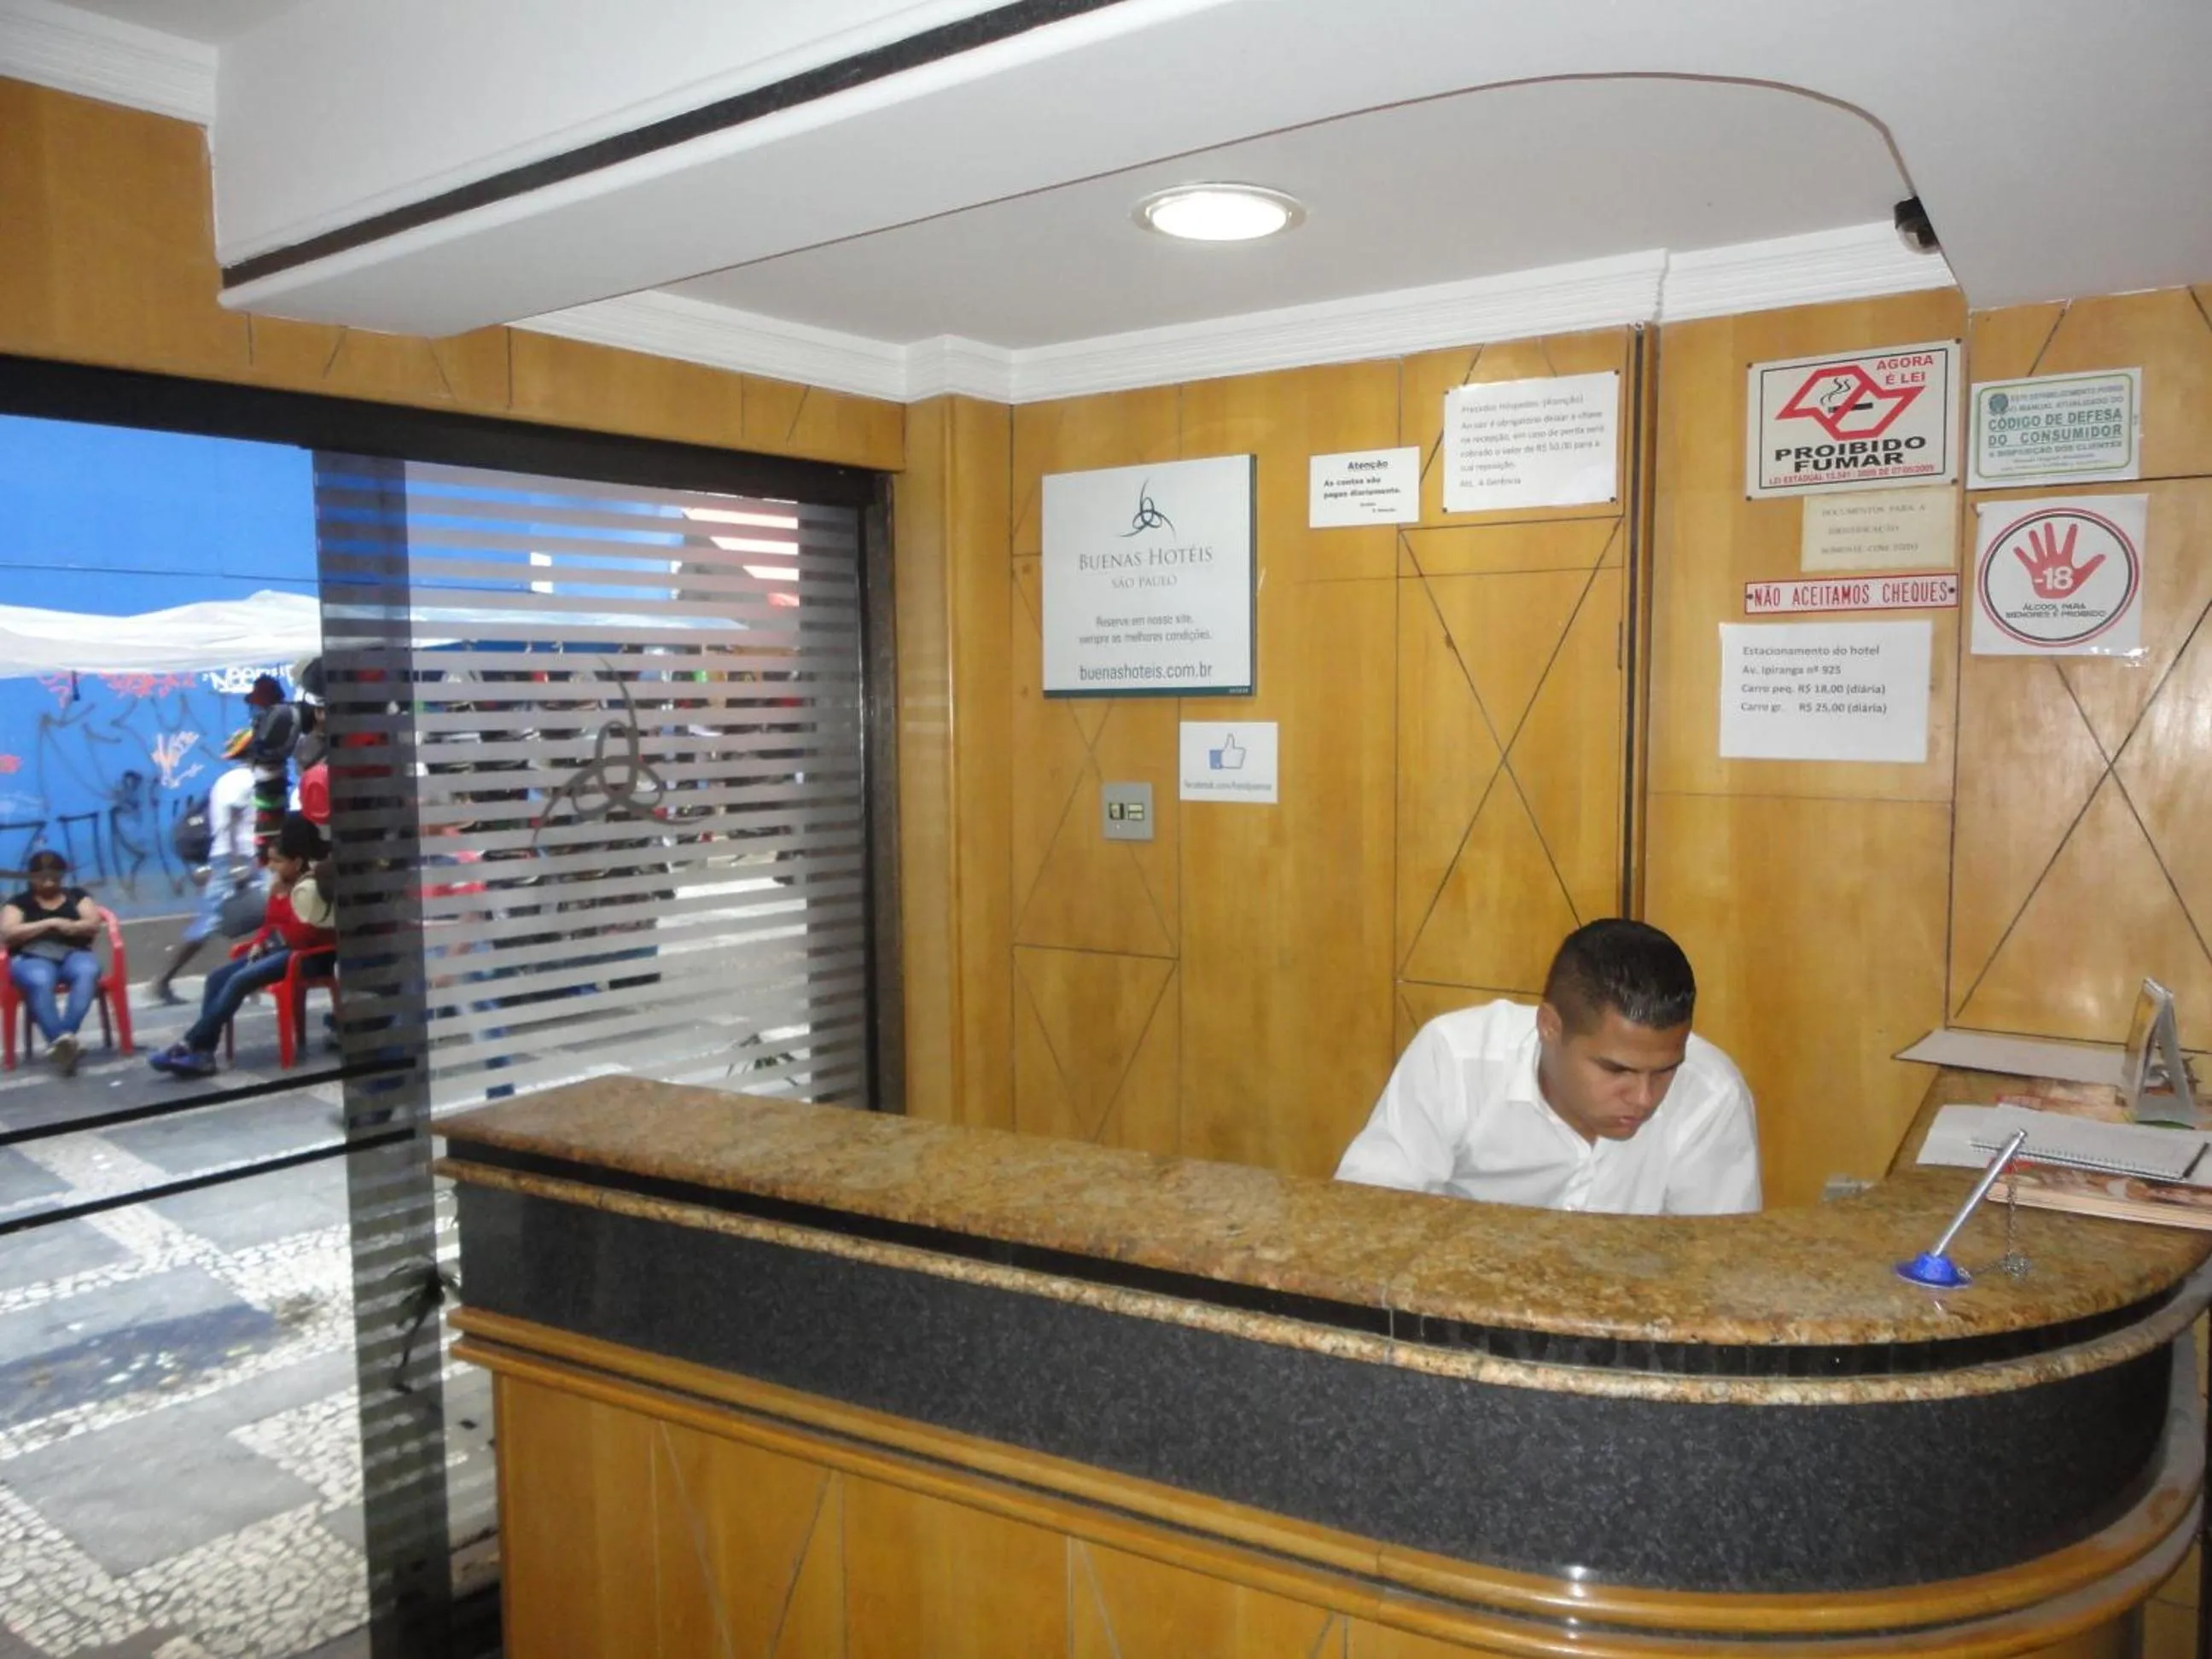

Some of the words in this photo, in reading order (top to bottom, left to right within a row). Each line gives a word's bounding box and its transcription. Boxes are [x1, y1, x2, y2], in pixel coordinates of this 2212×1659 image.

[1877, 354, 1934, 370] AGORA
[1885, 372, 1895, 385] É
[1901, 371, 1925, 383] LEI
[1988, 415, 2041, 431] CÓDIGO
[2046, 414, 2063, 426] DE
[2069, 408, 2123, 425] DEFESA
[1988, 434, 2007, 446] DO
[2020, 424, 2122, 444] CONSUMIDOR
[1775, 436, 1926, 462] PROIBIDO
[1348, 460, 1388, 471] Atenção
[1794, 452, 1904, 473] FUMAR
[1324, 479, 1334, 487] As
[1336, 477, 1364, 486] contas
[1784, 474, 1823, 484] ESTADUAL
[1079, 551, 1143, 571] BUENAS
[1149, 545, 1214, 566] HOTÉIS
[1112, 574, 1135, 589] SÃO
[1139, 574, 1178, 588] PAULO
[2034, 566, 2074, 591] -18
[1754, 585, 1781, 607] NÃO
[1792, 584, 1871, 607] ACEITAMOS
[1883, 581, 1948, 604] CHEQUES
[1132, 616, 1145, 626] em
[1742, 646, 1831, 656] Estacionamento
[1832, 644, 1848, 656] do
[1849, 643, 1880, 656] hotel
[1079, 661, 1214, 680] buenashoteis.com.br
[1761, 666, 1804, 676] Ipiranga
[1822, 665, 1842, 675] 925
[1741, 684, 1769, 693] Carro
[1797, 683, 1811, 693] R$
[1846, 683, 1886, 695] (diária)
[1741, 702, 1769, 712] Carro
[1799, 702, 1813, 713] R$
[1847, 702, 1888, 714] (diária)
